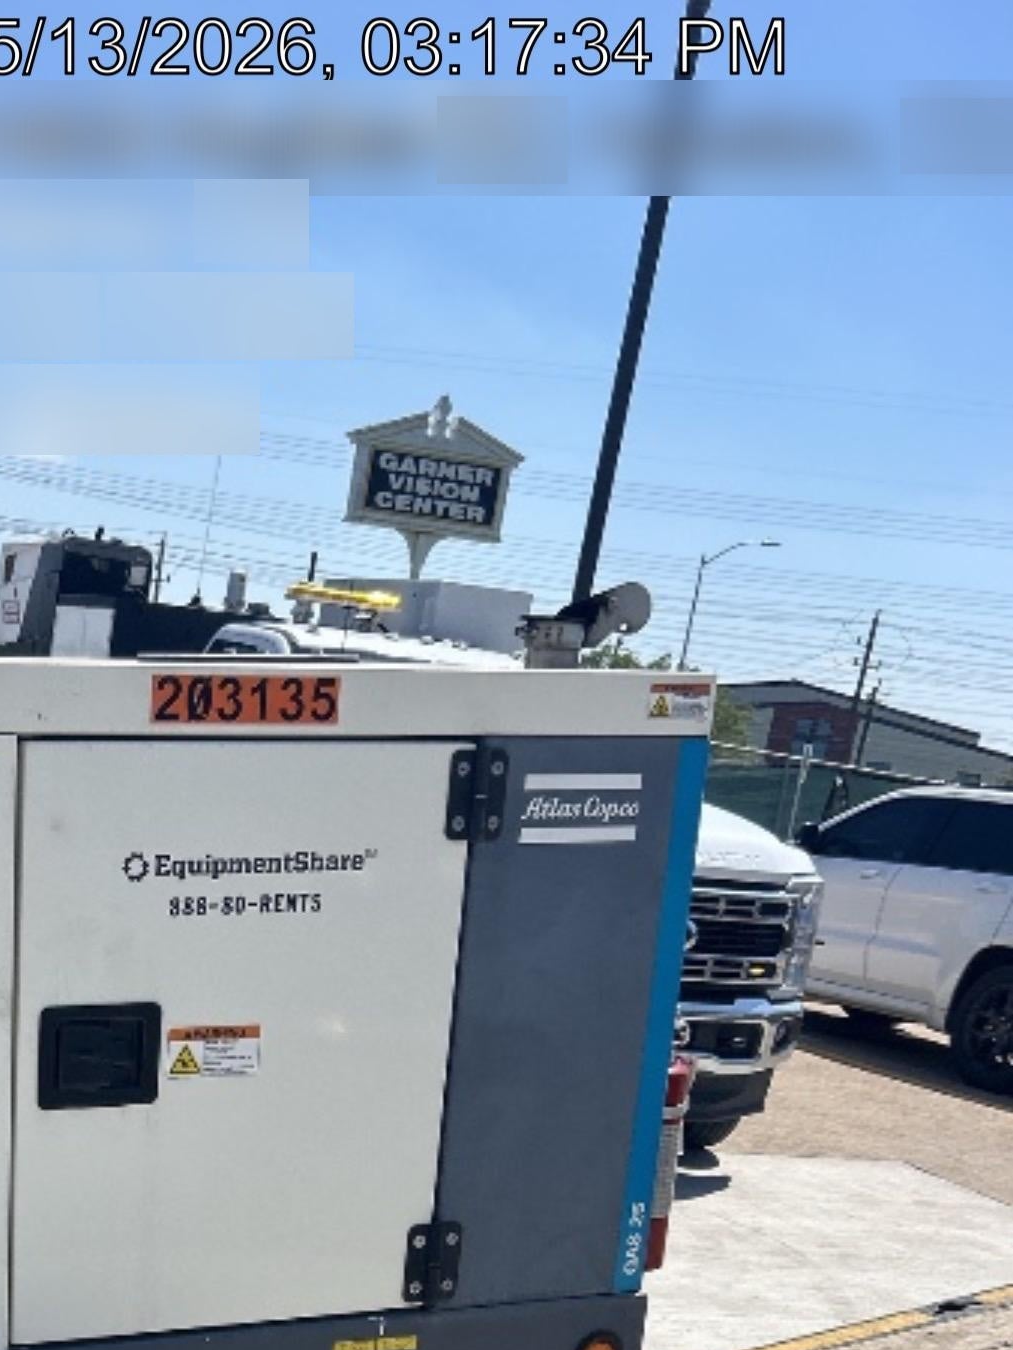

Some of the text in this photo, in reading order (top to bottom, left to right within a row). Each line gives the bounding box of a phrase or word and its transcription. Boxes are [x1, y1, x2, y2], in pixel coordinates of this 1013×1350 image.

[379, 452, 494, 487] GARNER
[389, 472, 481, 503] VISION
[374, 491, 486, 523] CENTER
[154, 675, 337, 721] 203135
[520, 795, 640, 823] Atlas Copco
